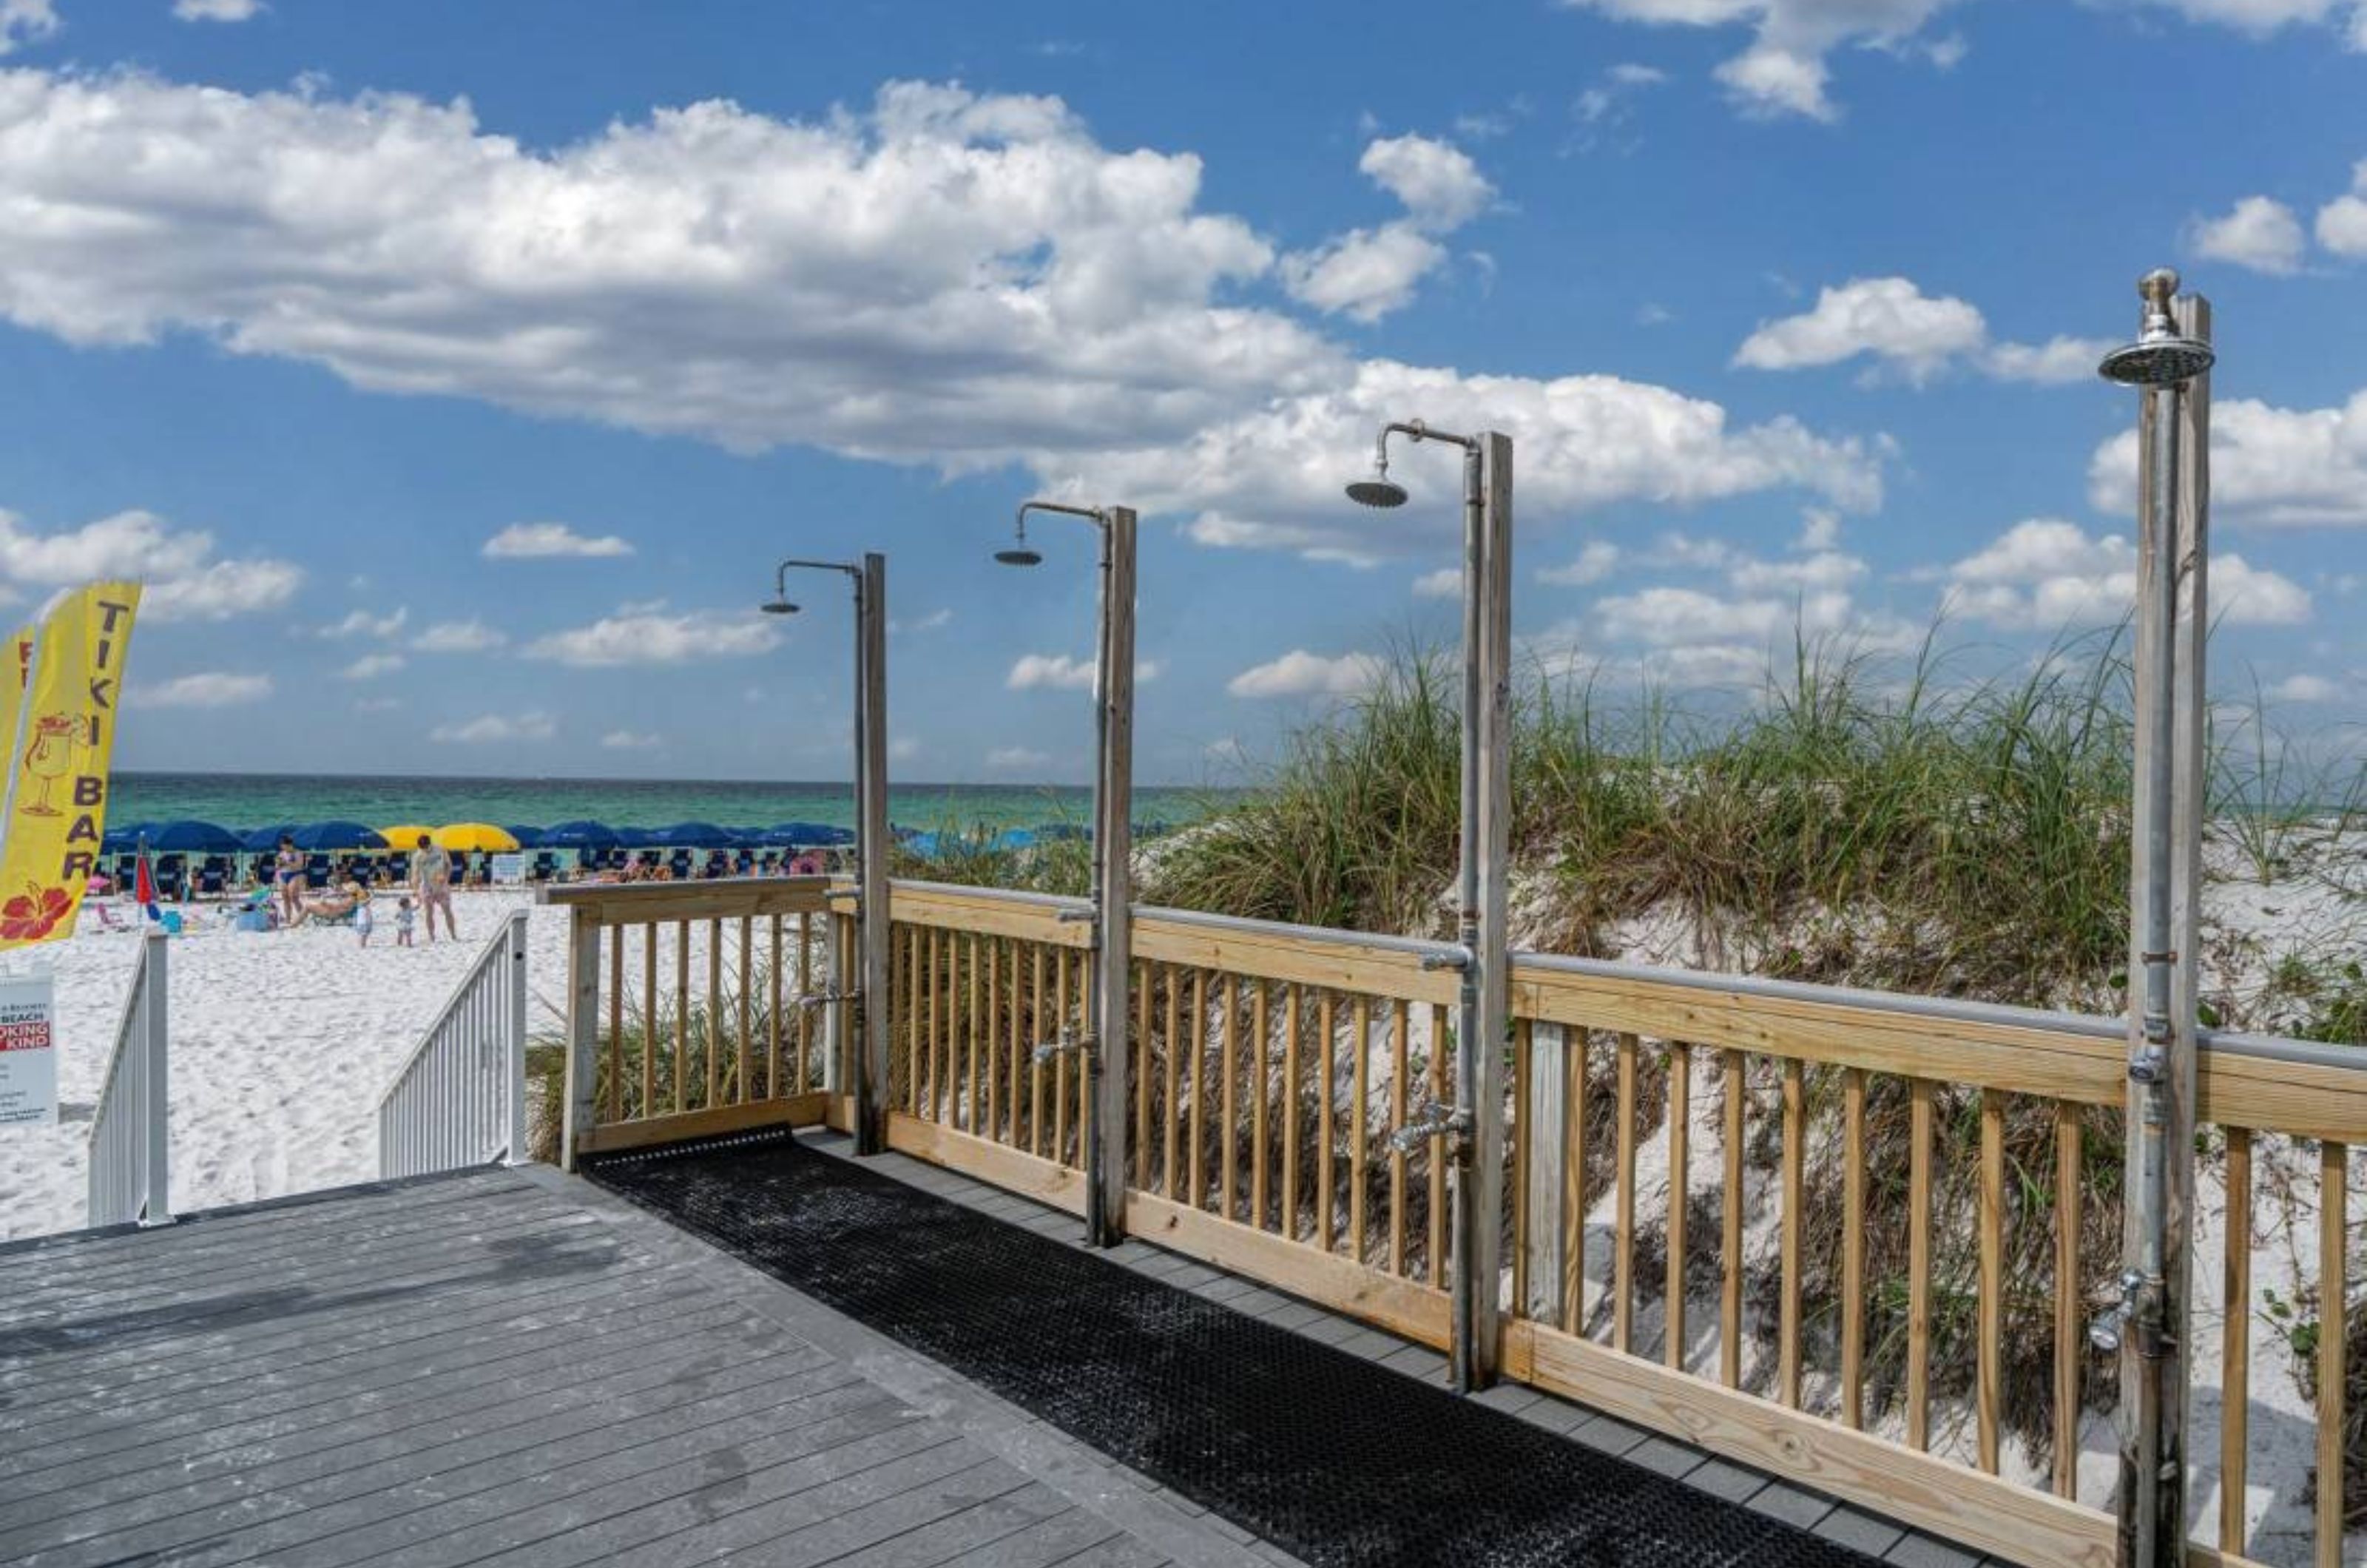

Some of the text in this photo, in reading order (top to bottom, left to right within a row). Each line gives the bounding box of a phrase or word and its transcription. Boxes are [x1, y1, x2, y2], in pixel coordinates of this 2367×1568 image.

[62, 601, 129, 880] TIKI BAR
[2, 1011, 44, 1024] BEACH
[6, 1036, 48, 1050] KIND
